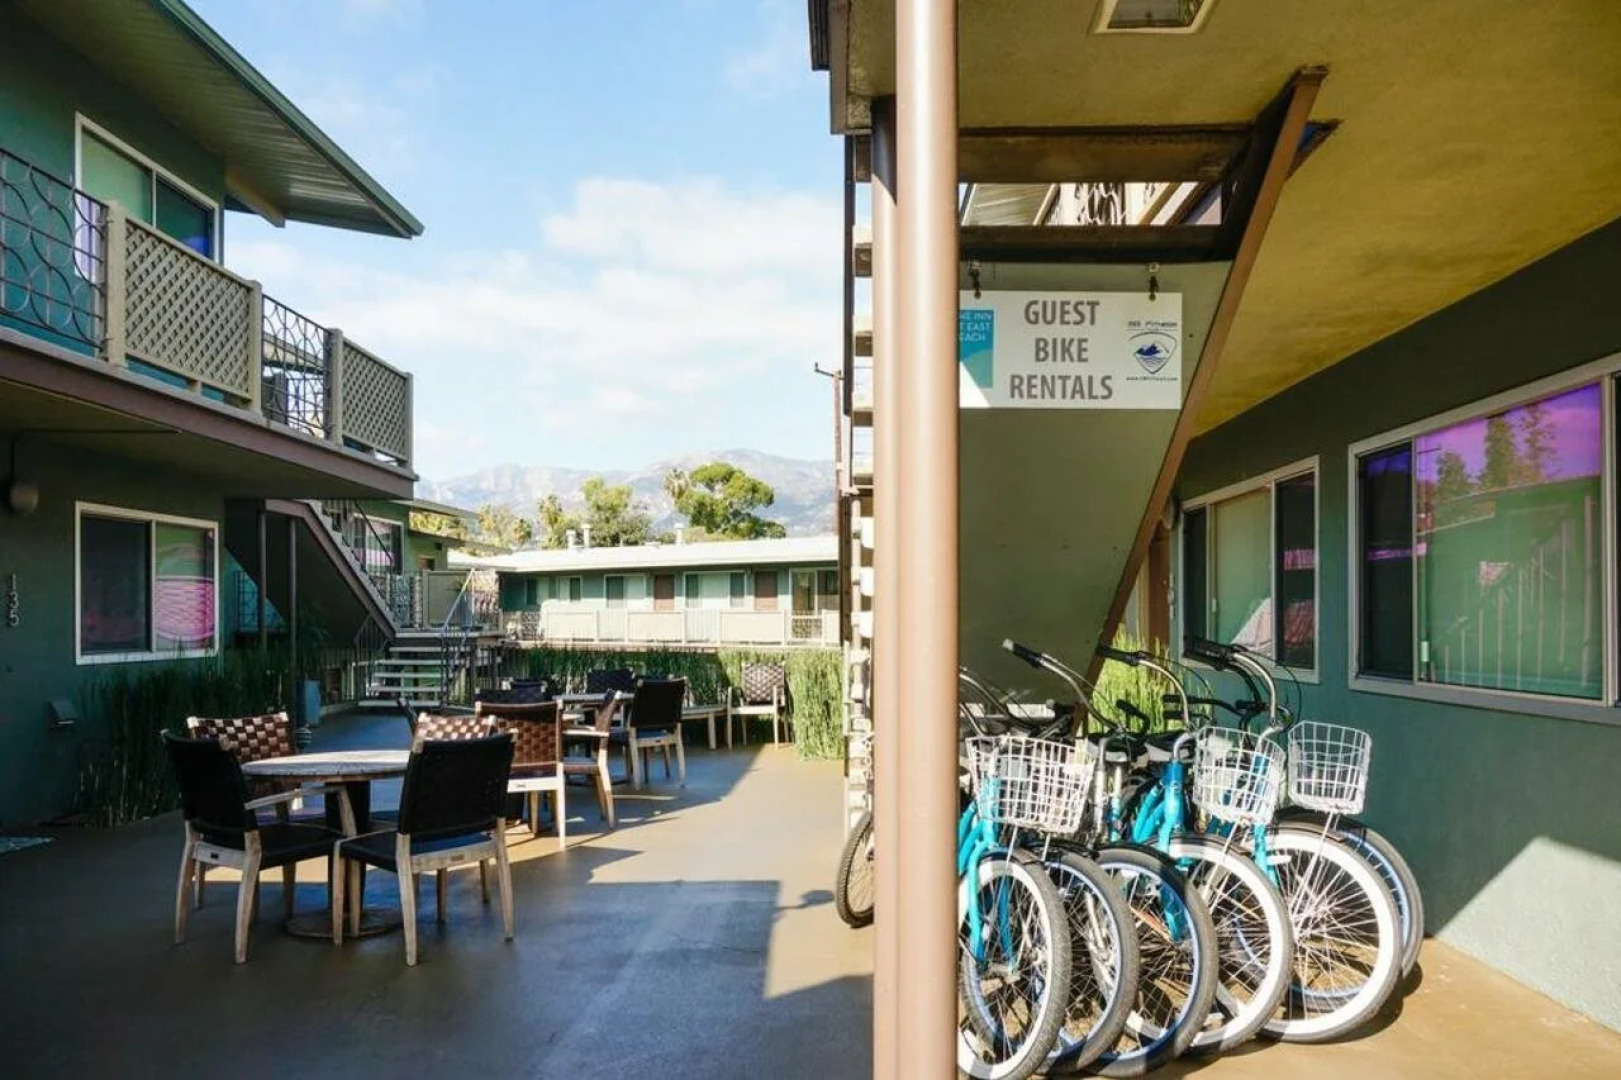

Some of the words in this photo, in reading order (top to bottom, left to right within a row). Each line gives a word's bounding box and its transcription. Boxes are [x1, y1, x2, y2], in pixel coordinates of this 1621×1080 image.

[1024, 299, 1100, 326] GUEST
[959, 332, 987, 342] EACH
[967, 322, 993, 331] EAST
[1034, 337, 1089, 363] BIKE
[1010, 374, 1113, 400] RENTALS
[9, 572, 20, 627] 135
